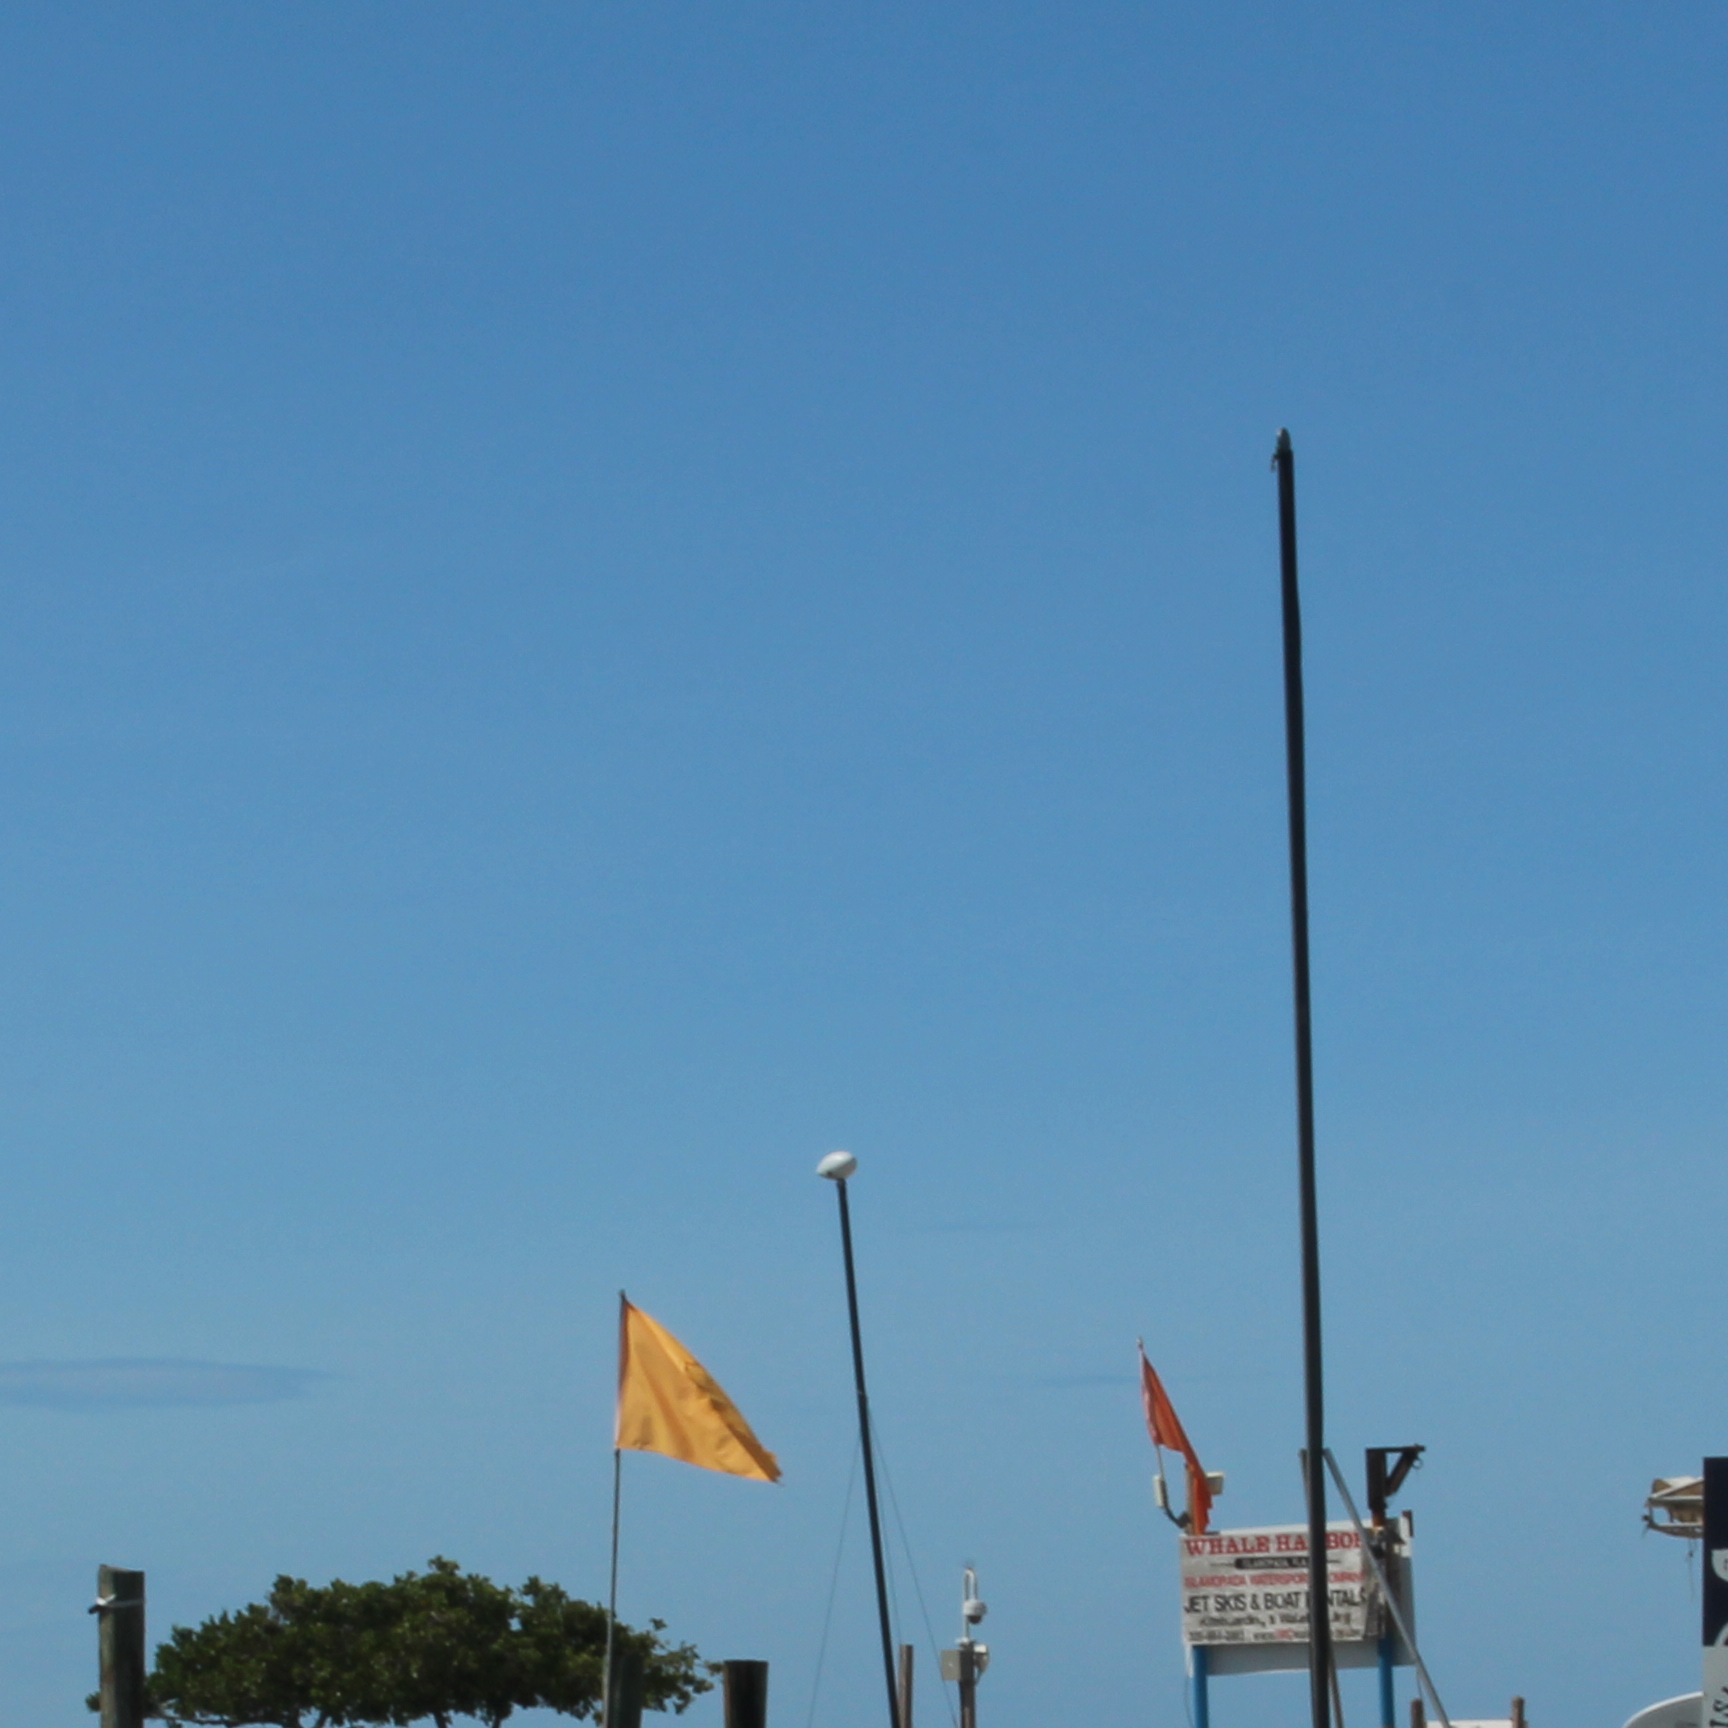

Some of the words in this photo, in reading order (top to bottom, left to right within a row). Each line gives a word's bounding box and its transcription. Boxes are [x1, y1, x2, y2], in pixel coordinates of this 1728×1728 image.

[1185, 1535, 1271, 1556] WHALE
[1276, 1532, 1362, 1551] HABO
[1184, 1595, 1209, 1613] JET
[1214, 1593, 1247, 1611] SKIS
[1251, 1593, 1262, 1610] &
[1264, 1591, 1301, 1609] BOAT
[1306, 1587, 1367, 1607] TALS
